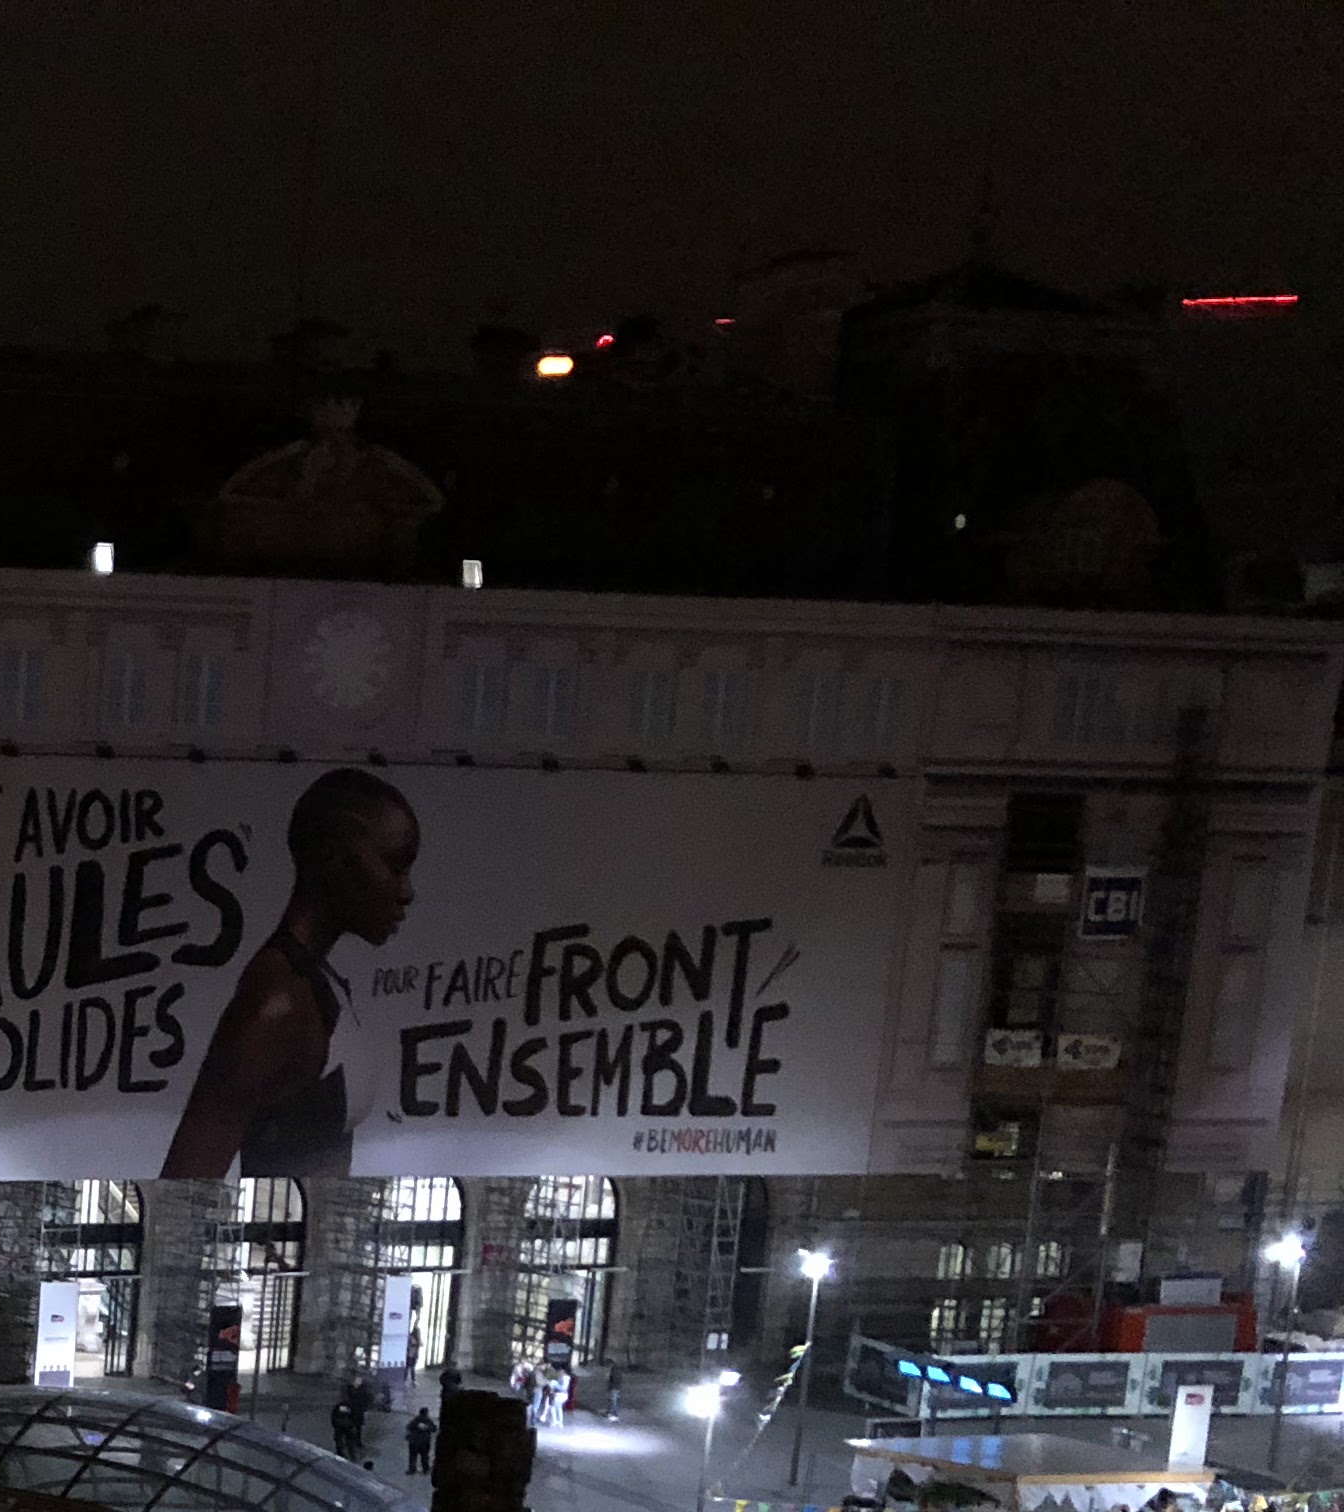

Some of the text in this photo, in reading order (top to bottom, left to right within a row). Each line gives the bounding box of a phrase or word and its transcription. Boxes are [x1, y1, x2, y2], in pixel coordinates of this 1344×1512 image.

[15, 788, 165, 862] AVOIR
[371, 917, 773, 1048] POUR FAIRE FRONT
[400, 1002, 790, 1118] ENSEMBLE
[632, 1128, 777, 1155] #BEMOREHUMAN
